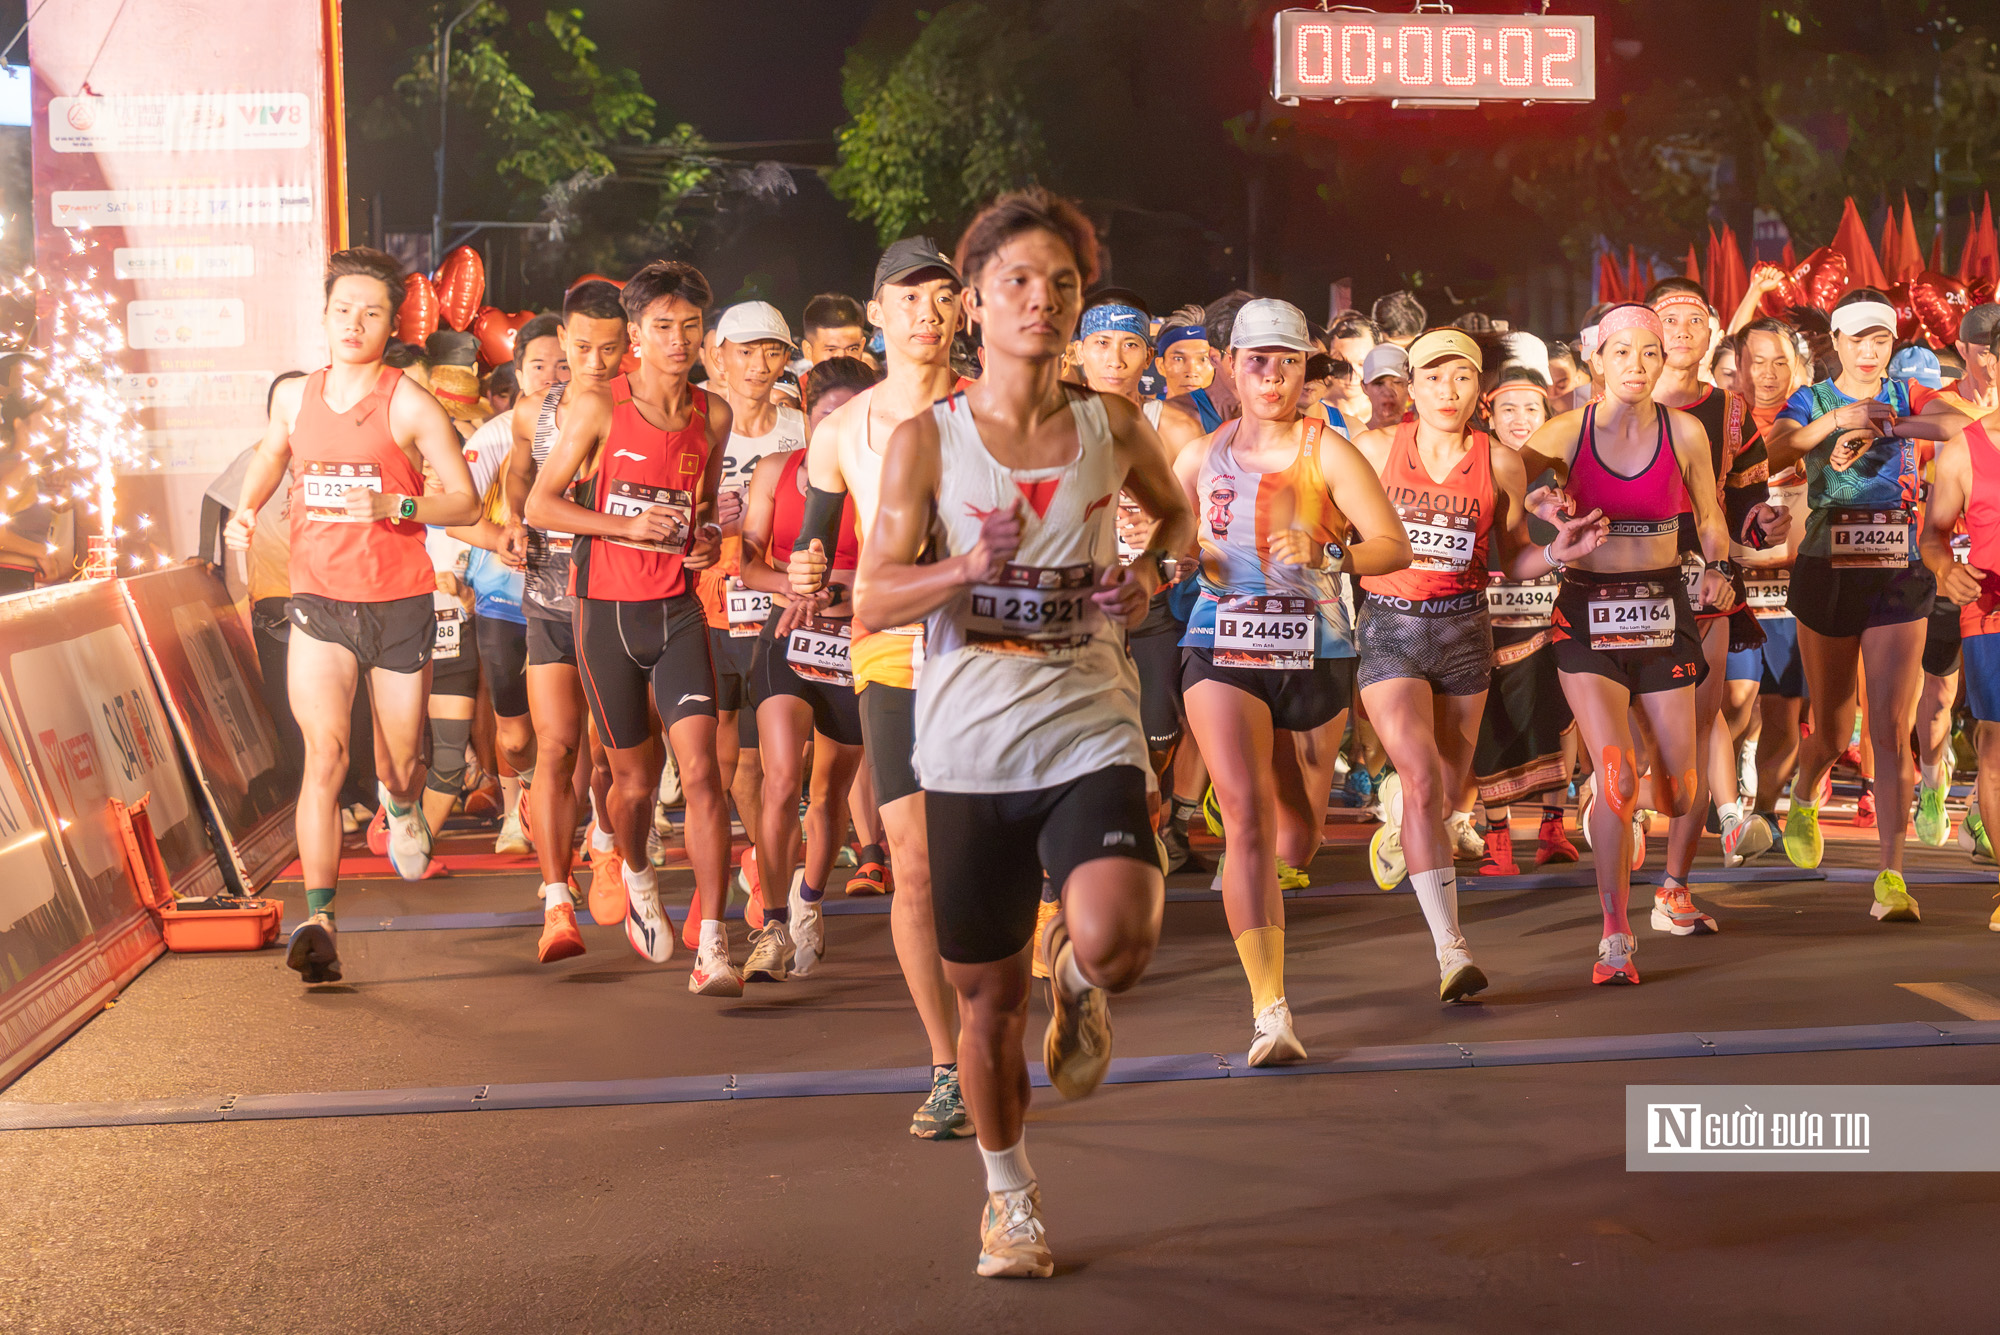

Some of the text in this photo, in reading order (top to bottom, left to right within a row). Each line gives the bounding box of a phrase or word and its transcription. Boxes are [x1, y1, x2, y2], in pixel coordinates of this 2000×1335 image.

[1298, 24, 1576, 86] 00:00:02
[1409, 529, 1468, 552] 23732
[1854, 530, 1904, 545] 24244
[1420, 594, 1476, 613] NIKE
[1506, 591, 1553, 606] 24394
[1004, 597, 1083, 624] 23921
[1614, 605, 1671, 623] 24164
[1242, 621, 1308, 639] 24459
[814, 641, 852, 661] 244
